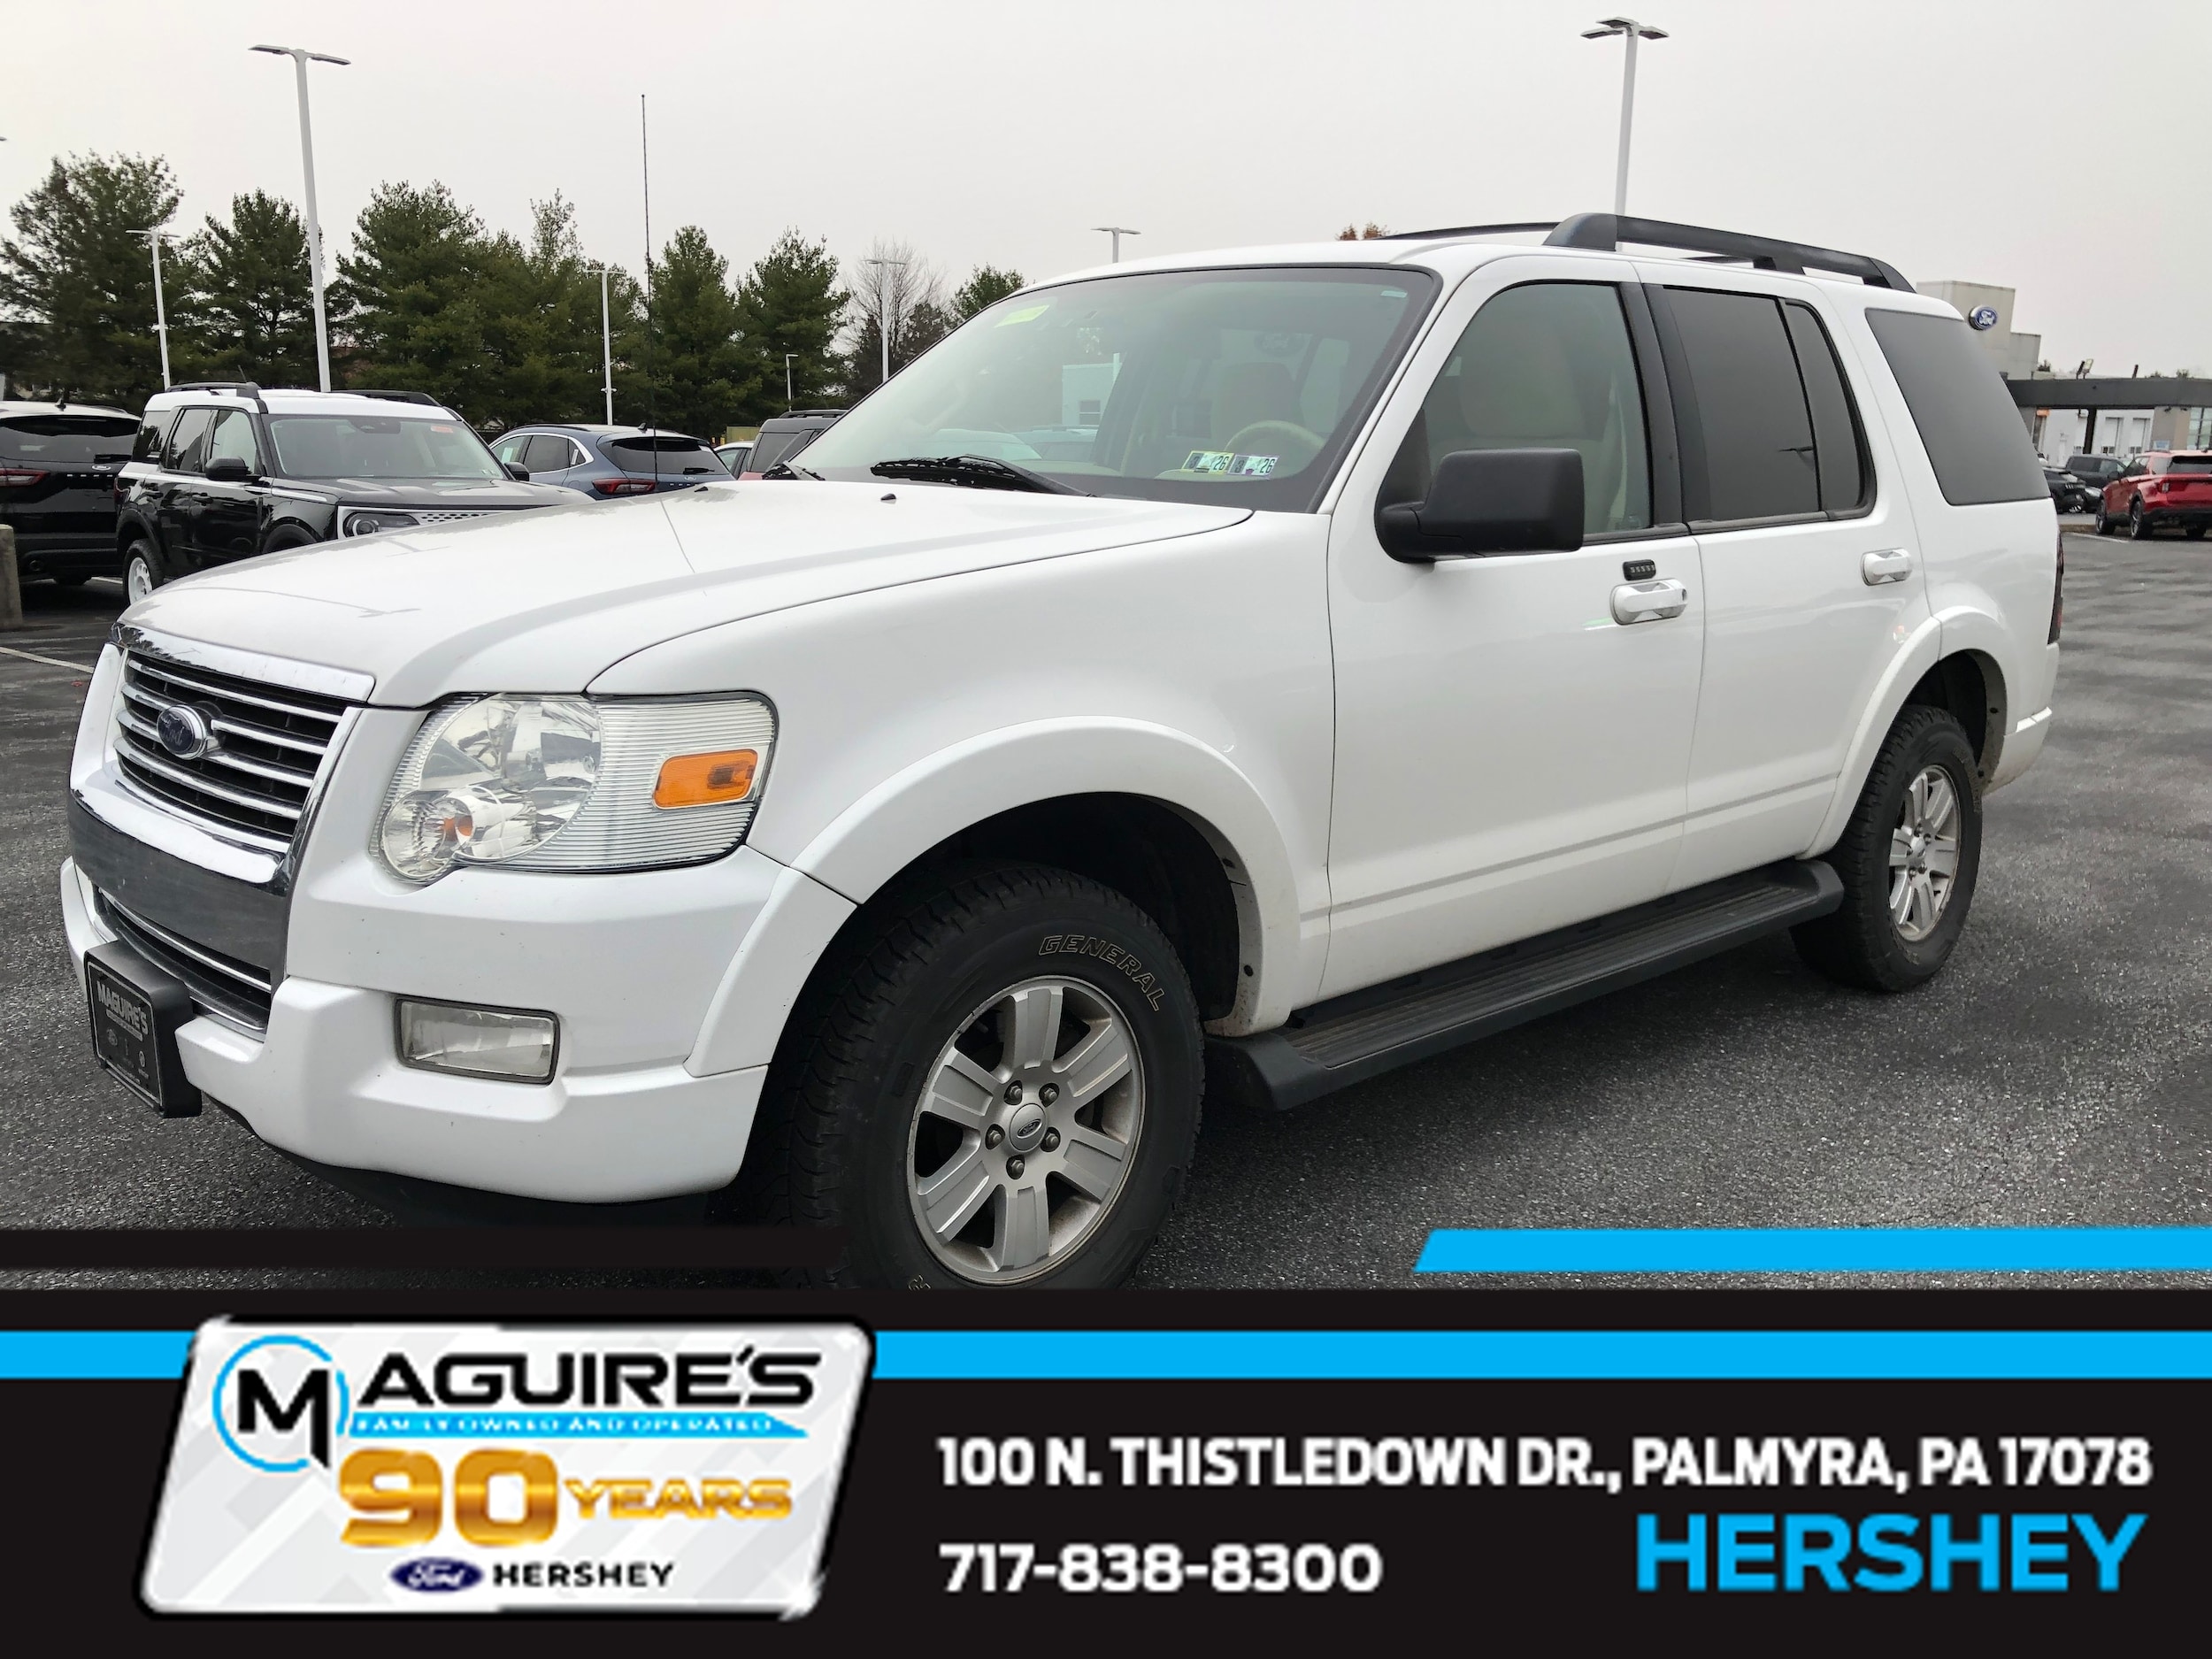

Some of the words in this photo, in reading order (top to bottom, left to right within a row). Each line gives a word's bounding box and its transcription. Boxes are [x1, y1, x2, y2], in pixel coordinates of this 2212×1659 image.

[1213, 456, 1229, 470] 26
[1260, 458, 1276, 473] 26
[1038, 934, 1165, 1011] GENERAL
[96, 980, 149, 1035] MAGUIRE'S
